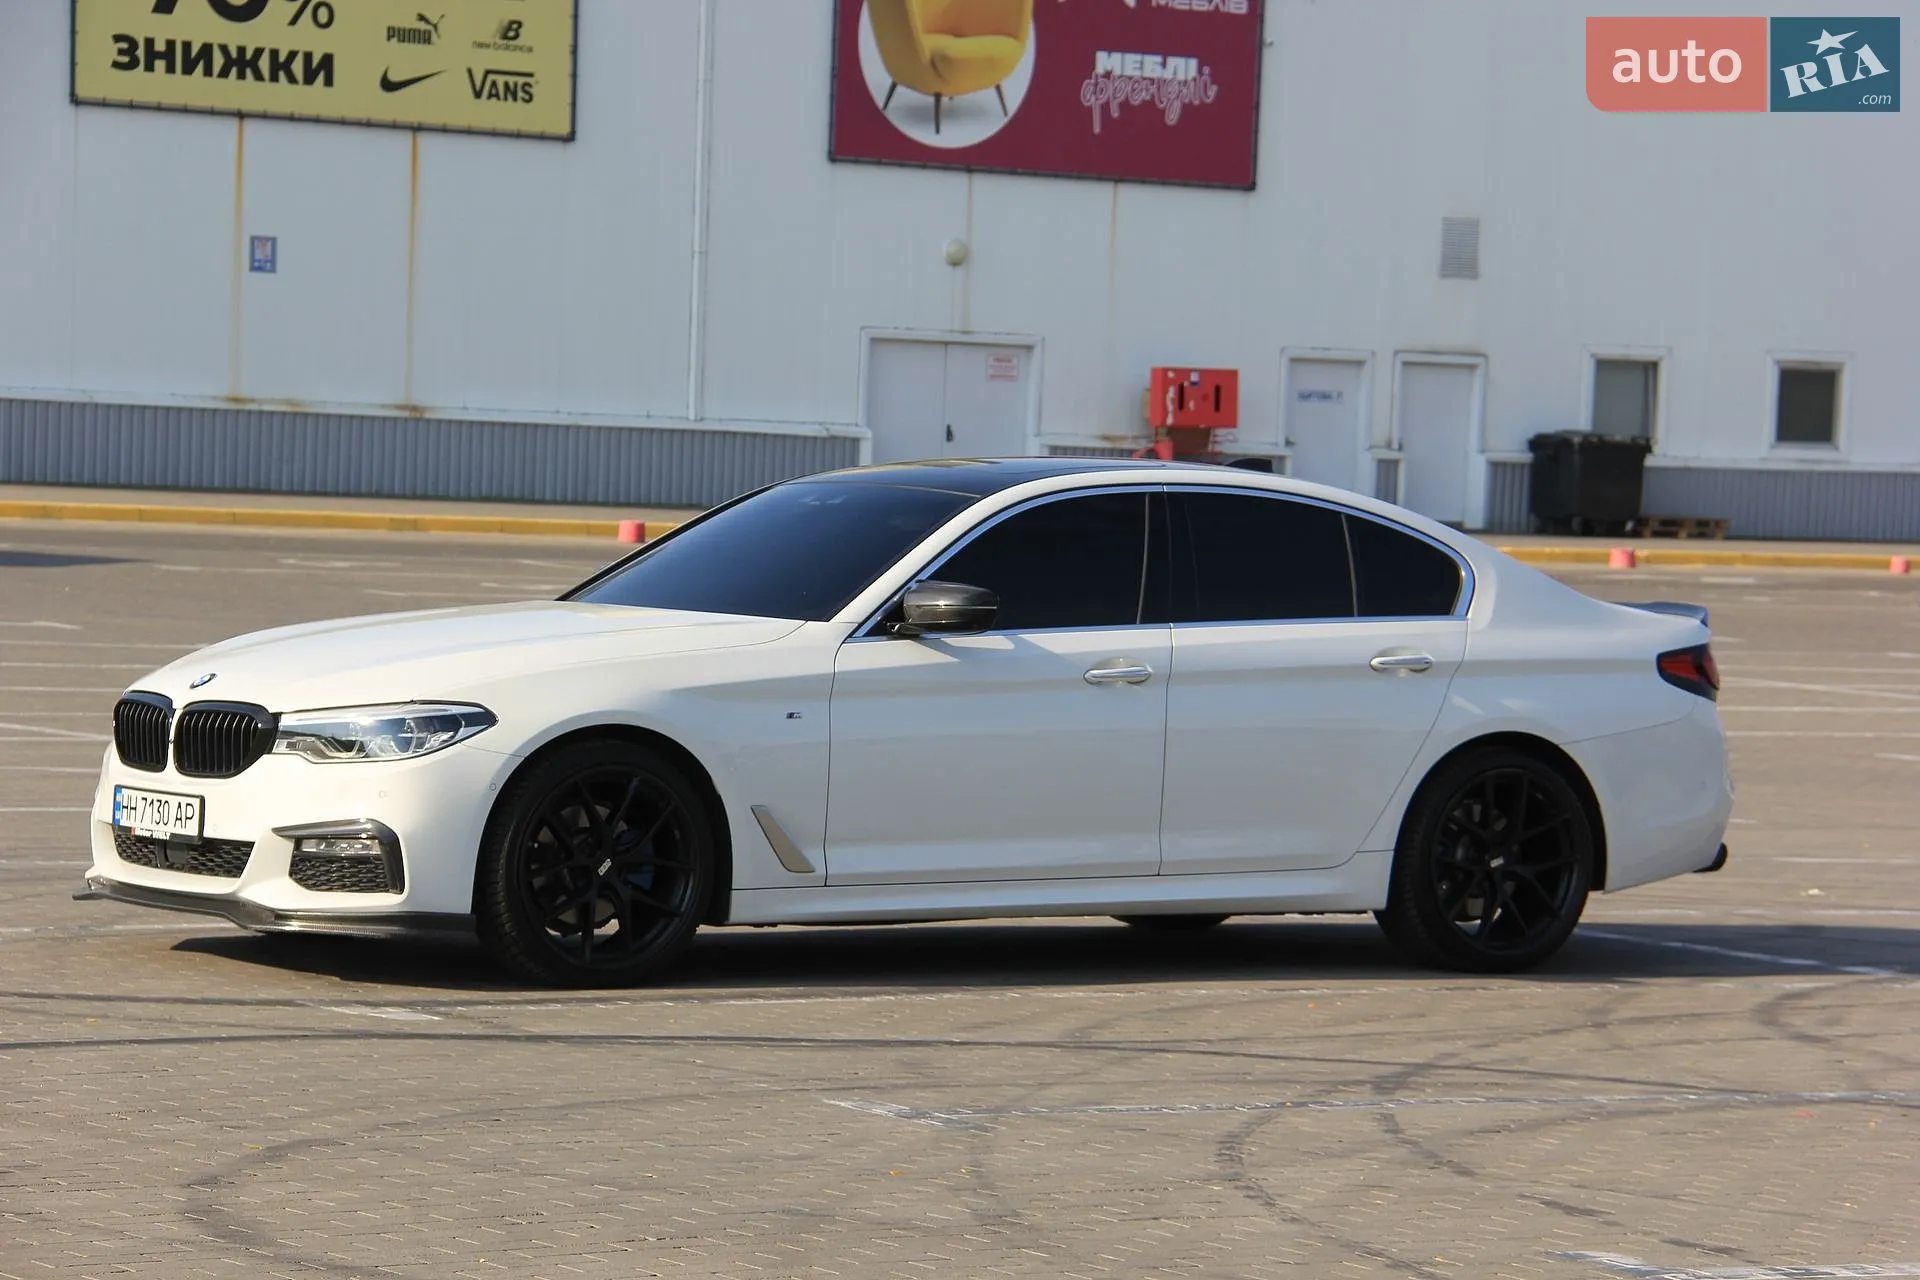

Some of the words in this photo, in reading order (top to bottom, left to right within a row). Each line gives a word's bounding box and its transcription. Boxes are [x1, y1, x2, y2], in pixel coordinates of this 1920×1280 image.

[387, 26, 433, 45] PUMA
[472, 40, 491, 50] new
[493, 41, 533, 53] balance
[111, 34, 334, 87] ЗНИЖКИ
[1095, 51, 1199, 80] МЕБЛІ
[466, 67, 535, 103] VANS
[121, 794, 138, 822] HH
[140, 797, 170, 826] 7130
[174, 801, 195, 829] AP
